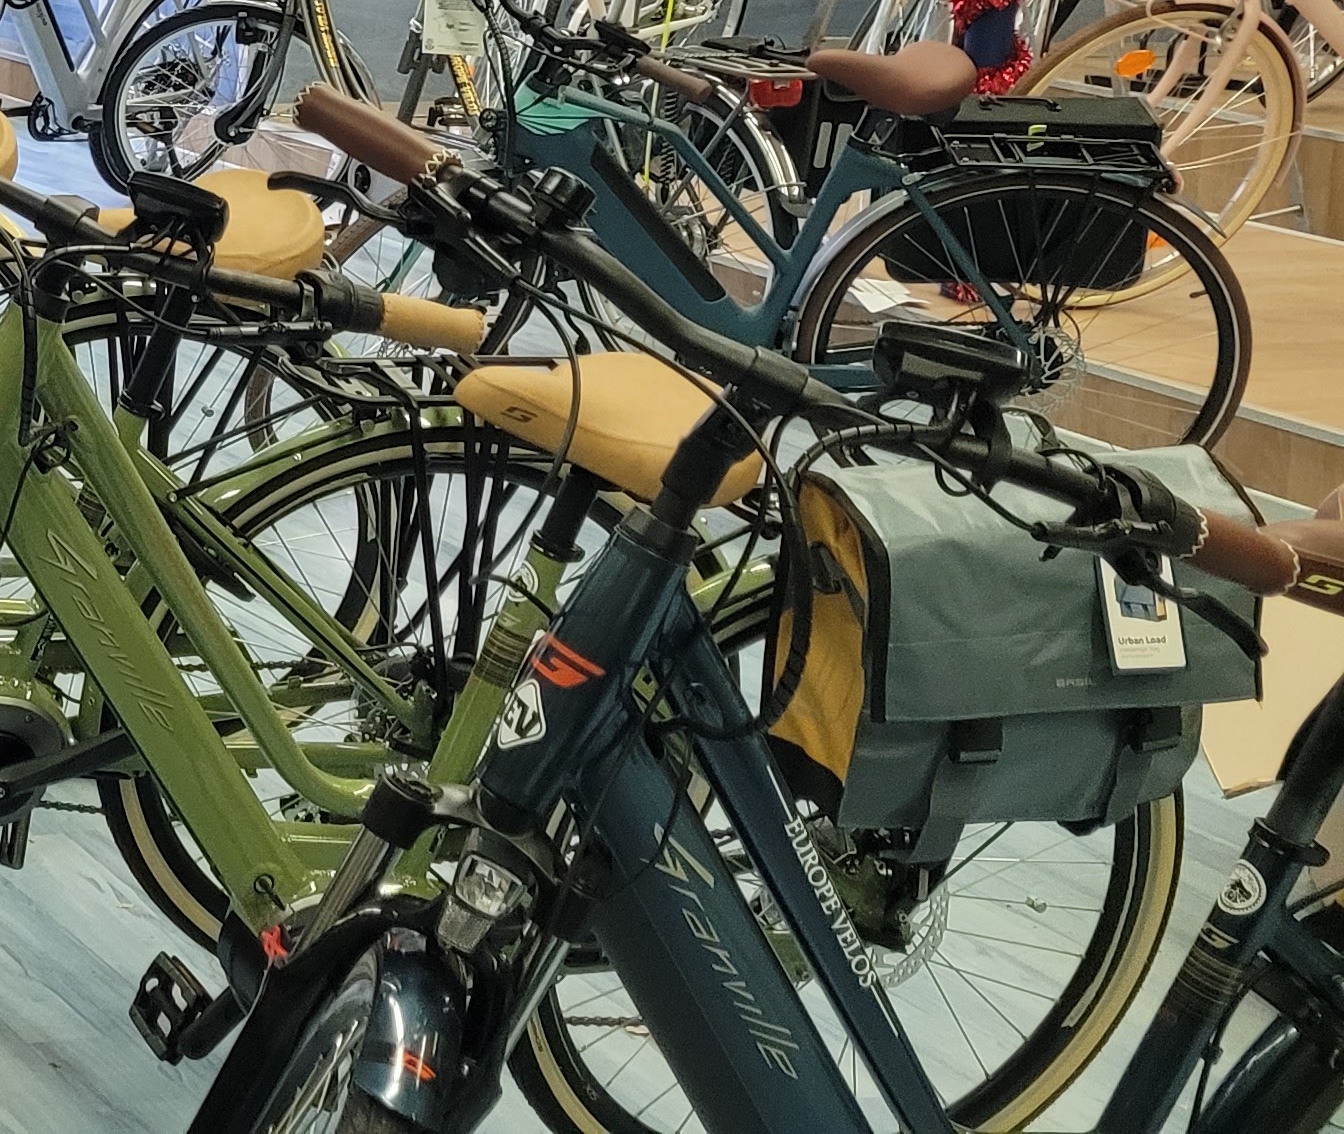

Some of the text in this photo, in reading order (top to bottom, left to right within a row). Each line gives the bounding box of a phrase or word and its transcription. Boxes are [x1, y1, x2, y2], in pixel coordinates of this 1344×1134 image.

[38, 529, 174, 732] Granville
[1118, 635, 1167, 646] Urban Load
[640, 822, 800, 1081] Granville
[786, 817, 876, 989] EUROPE VELOS
